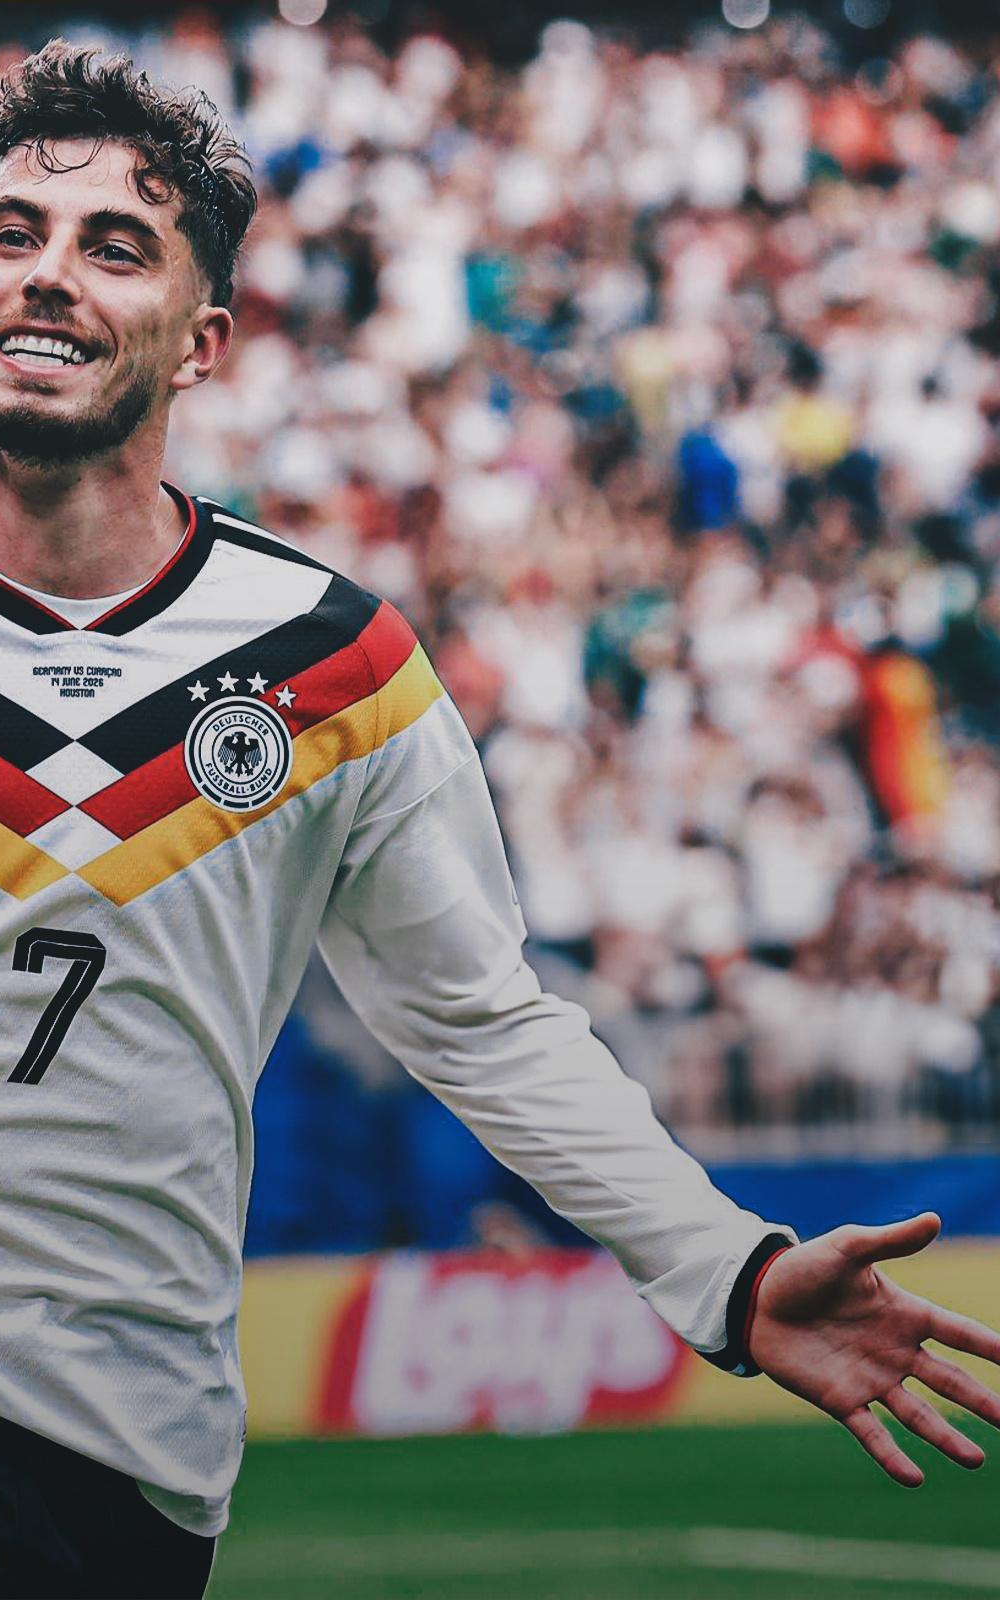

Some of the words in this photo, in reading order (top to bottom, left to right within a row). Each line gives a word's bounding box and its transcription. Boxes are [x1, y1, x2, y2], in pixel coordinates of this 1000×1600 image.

[33, 666, 71, 675] GERMANY
[86, 666, 122, 677] CURAÇAO
[51, 678, 59, 686] 14
[62, 677, 80, 686] JUNE
[83, 678, 104, 687] 2026
[60, 688, 95, 698] HOUSTON
[213, 714, 269, 736] DEUTSCHER
[205, 762, 273, 794] FUSSBALL-BUND
[7, 927, 107, 1085] 7
